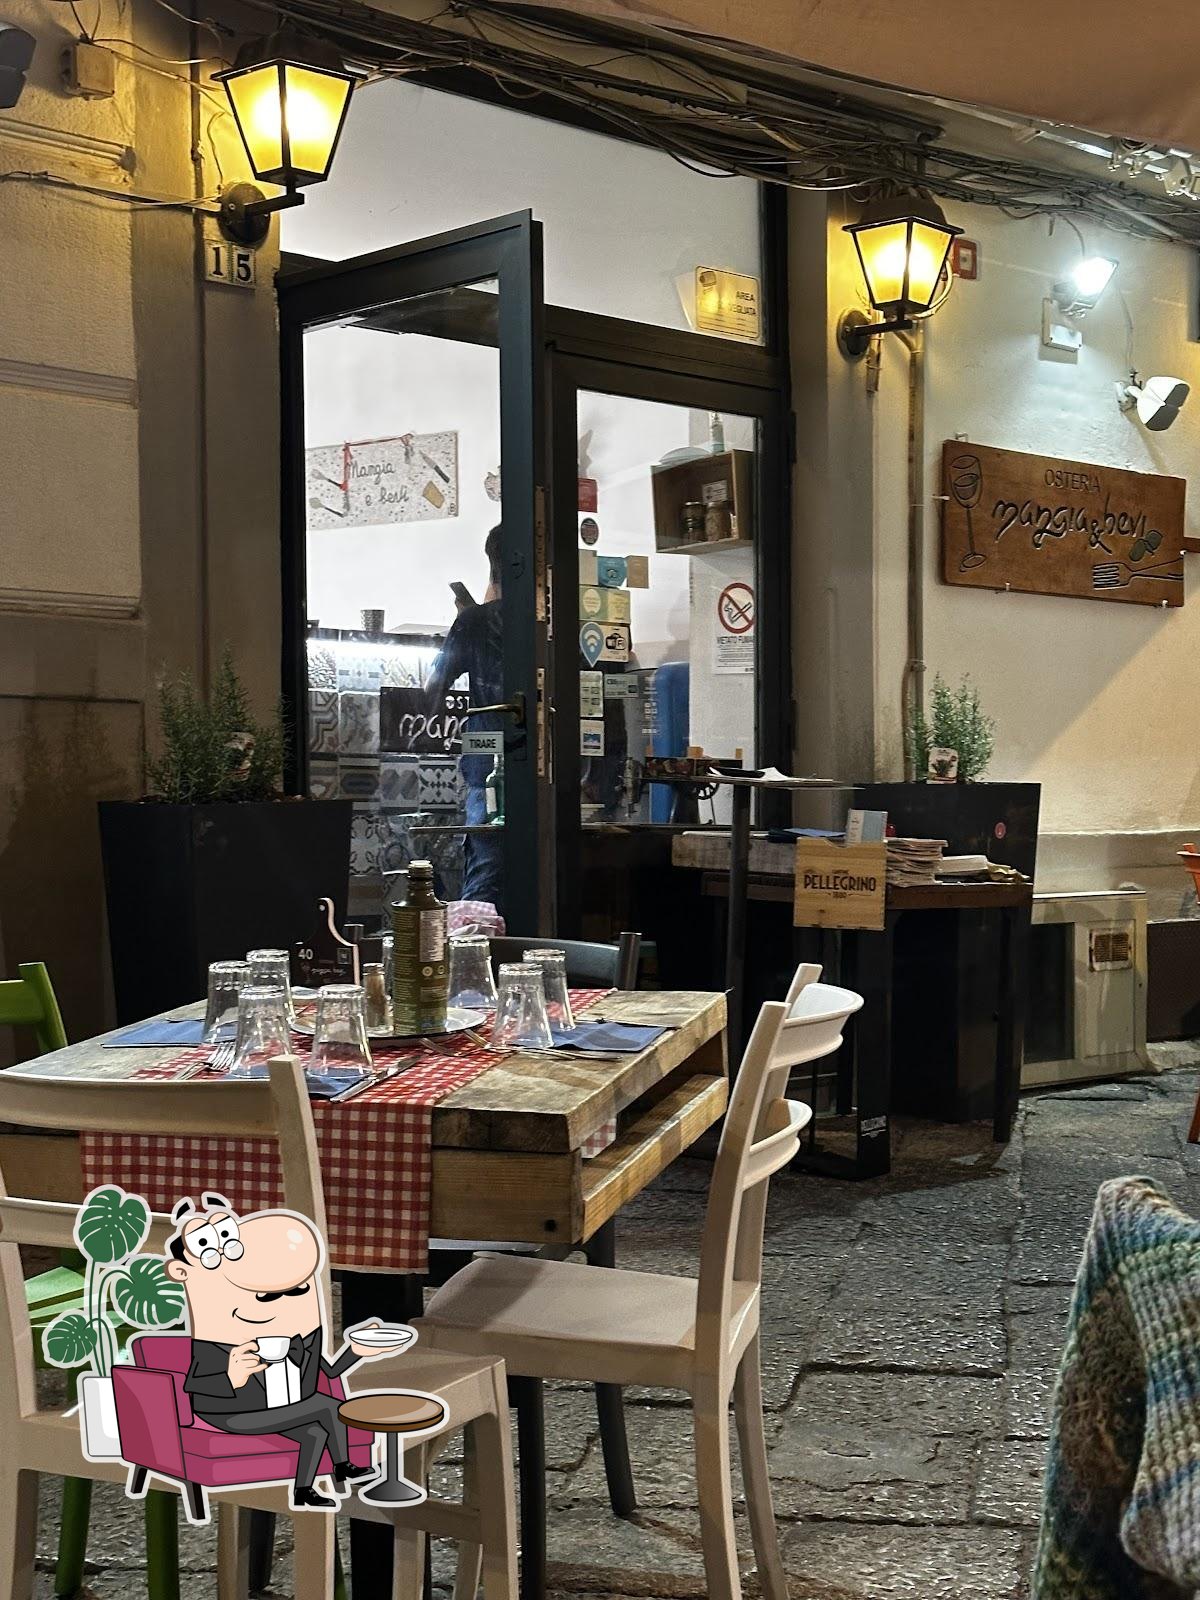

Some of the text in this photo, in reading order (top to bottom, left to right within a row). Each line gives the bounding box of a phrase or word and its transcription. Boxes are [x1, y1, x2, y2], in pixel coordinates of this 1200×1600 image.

[212, 246, 251, 281] 15
[736, 291, 755, 302] AREA
[1044, 469, 1101, 493] OSTERIA
[470, 738, 497, 749] TIRARE
[803, 874, 877, 892] PELLEGRINO
[298, 948, 314, 960] 40
